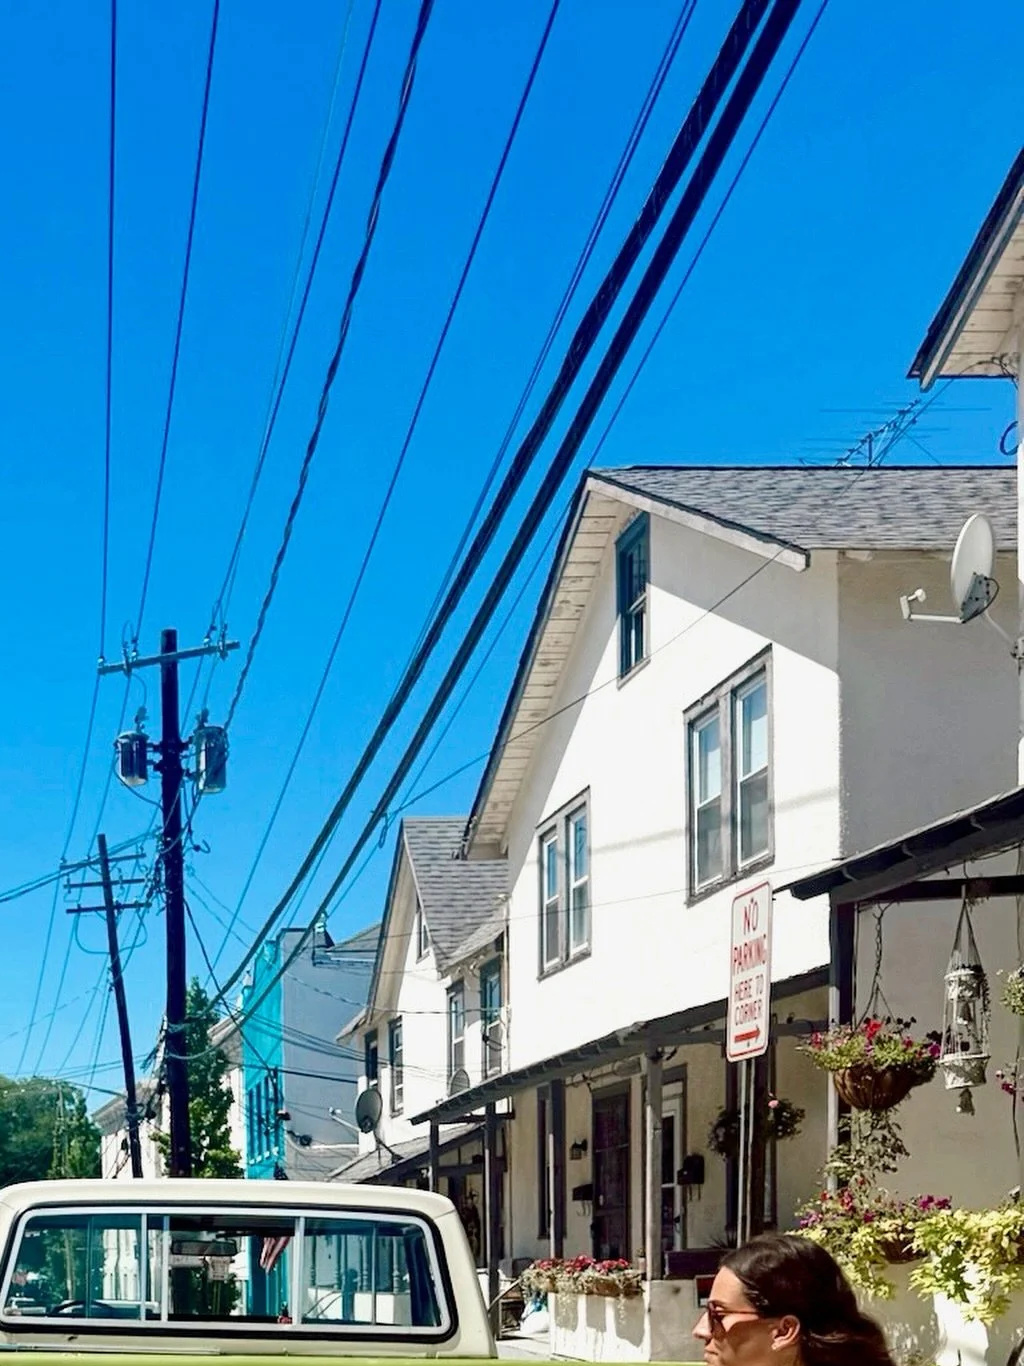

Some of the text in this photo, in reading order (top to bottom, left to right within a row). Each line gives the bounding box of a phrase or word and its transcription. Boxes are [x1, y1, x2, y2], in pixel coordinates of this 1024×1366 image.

[743, 899, 759, 935] NO
[733, 933, 768, 975] PARKING
[734, 974, 764, 1002] HERE TO
[735, 998, 763, 1026] CORNER
